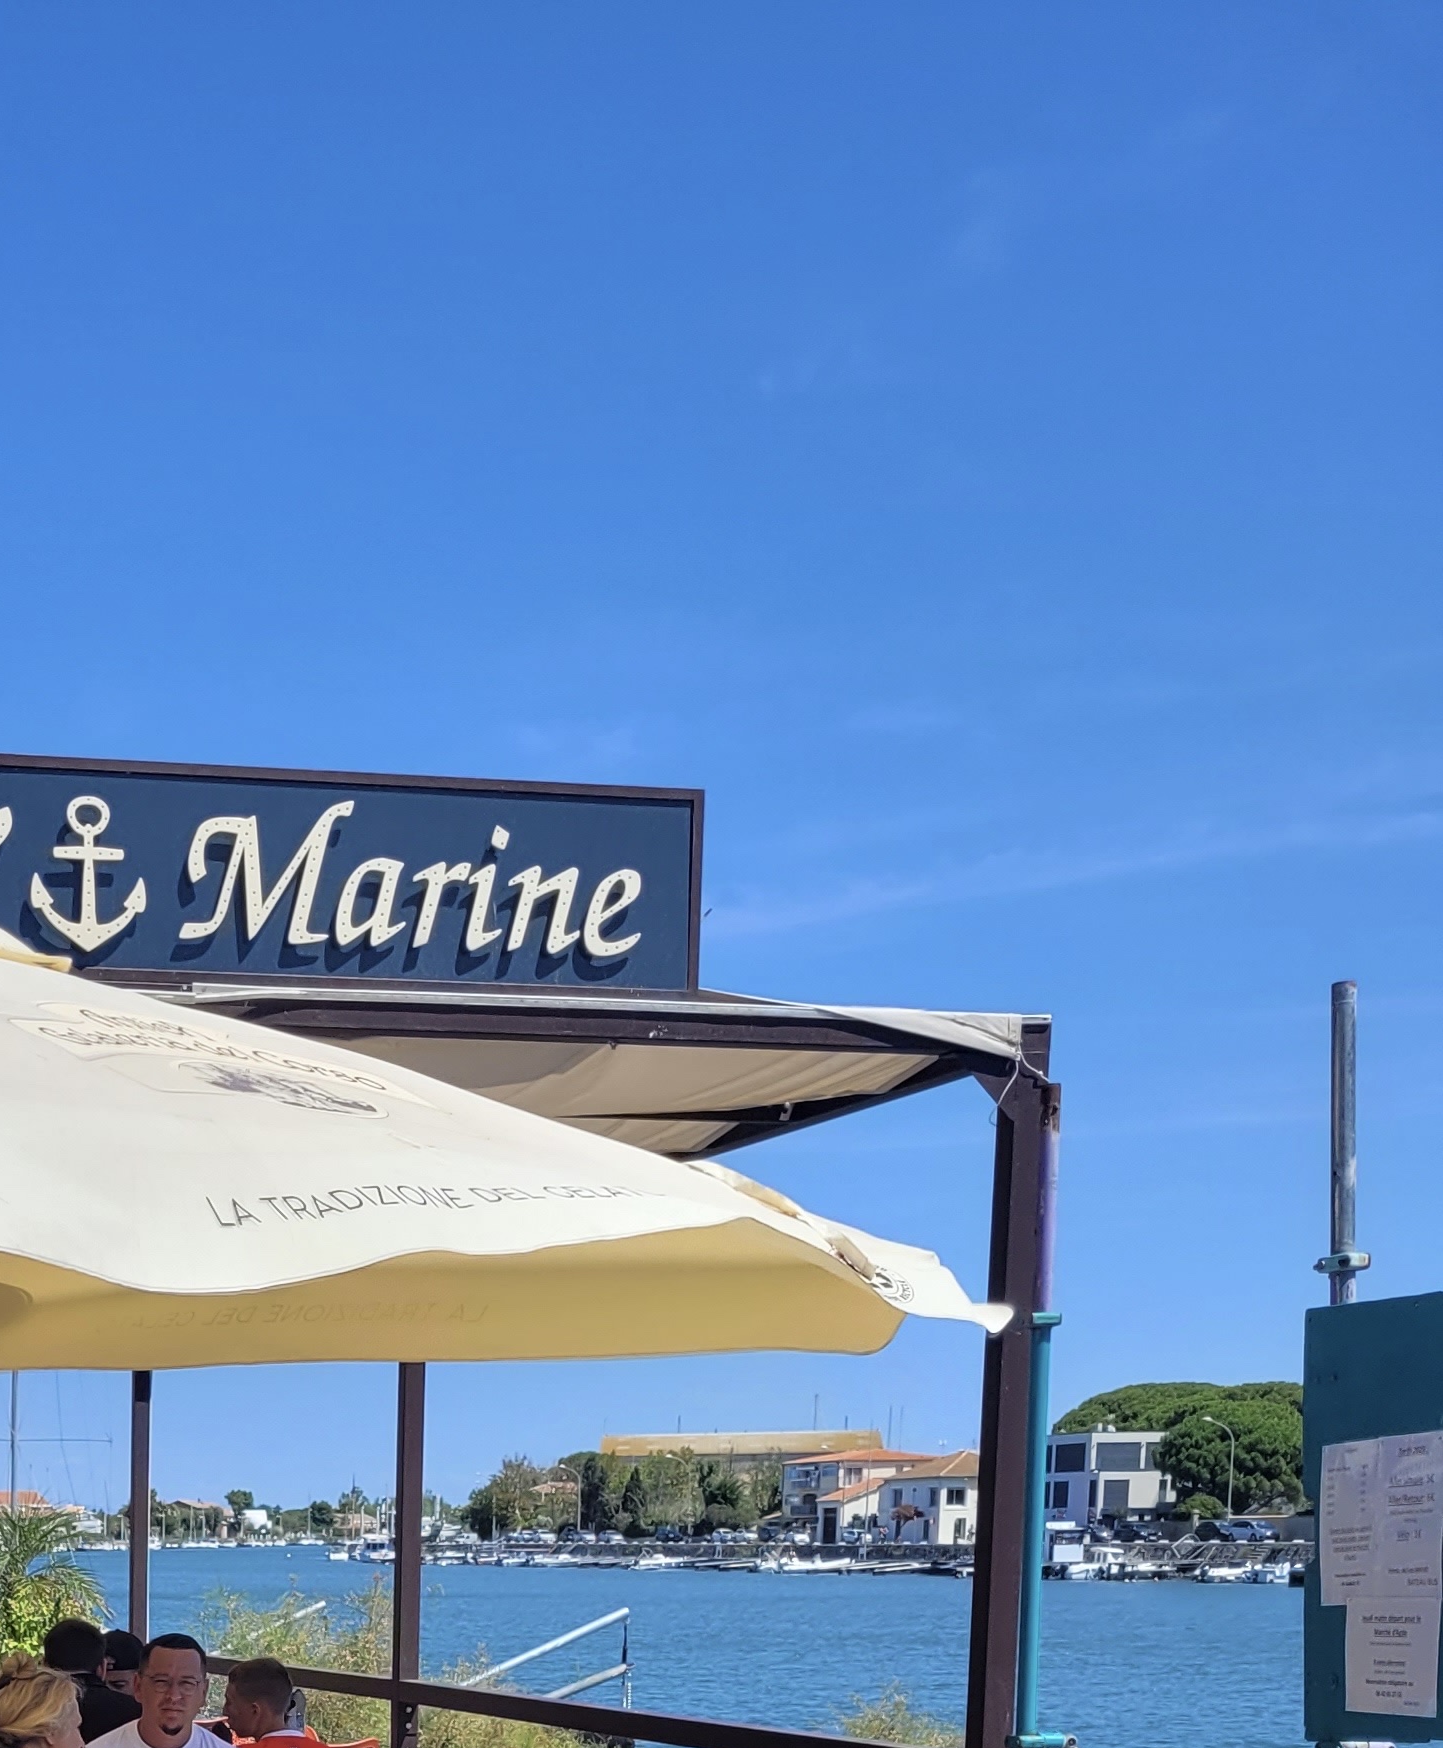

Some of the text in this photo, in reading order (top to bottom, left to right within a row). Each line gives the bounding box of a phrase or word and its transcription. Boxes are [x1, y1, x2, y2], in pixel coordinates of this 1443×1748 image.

[178, 800, 642, 957] Marine
[206, 1196, 262, 1228] LA
[259, 1184, 475, 1221] TRADIZIONE
[467, 1187, 546, 1203] DEL
